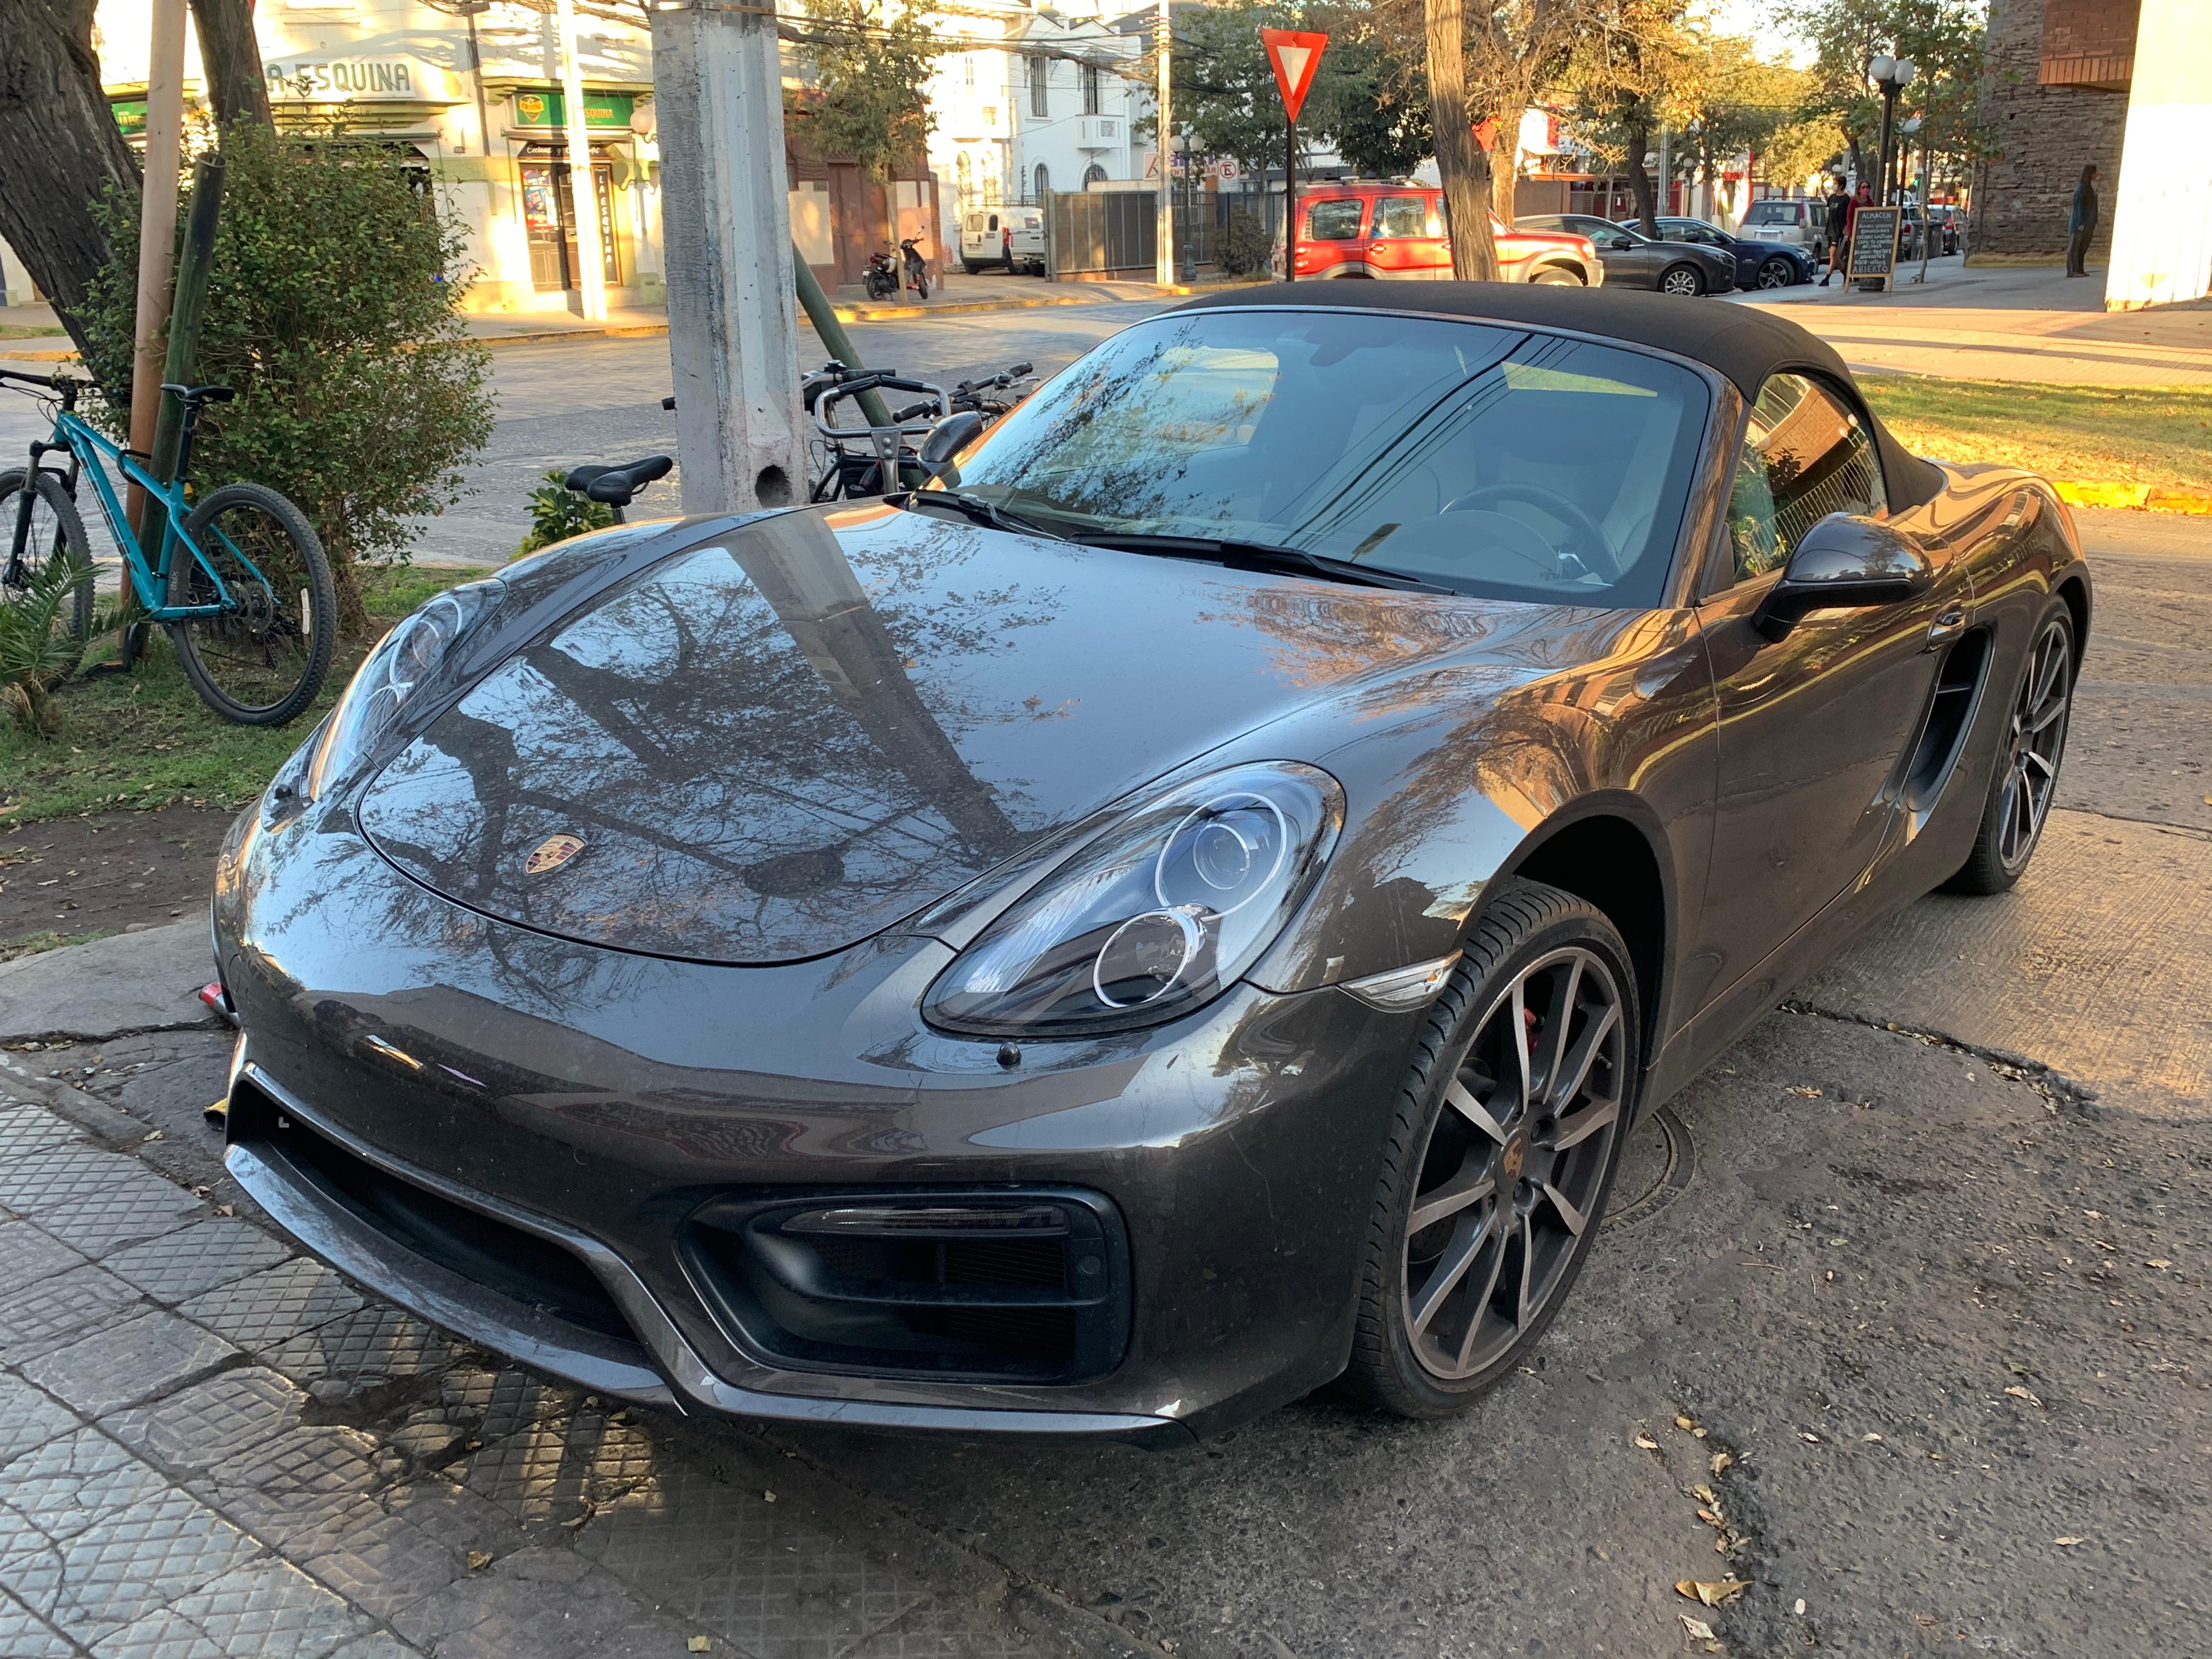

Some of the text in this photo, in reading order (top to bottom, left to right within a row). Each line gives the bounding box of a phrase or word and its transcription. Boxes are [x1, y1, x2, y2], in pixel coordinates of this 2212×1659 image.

[266, 63, 410, 92] A ESQUINA
[585, 109, 614, 118] SQUINA
[599, 176, 612, 263] LA ESQUINA
[1852, 265, 1888, 273] ABIERTO
